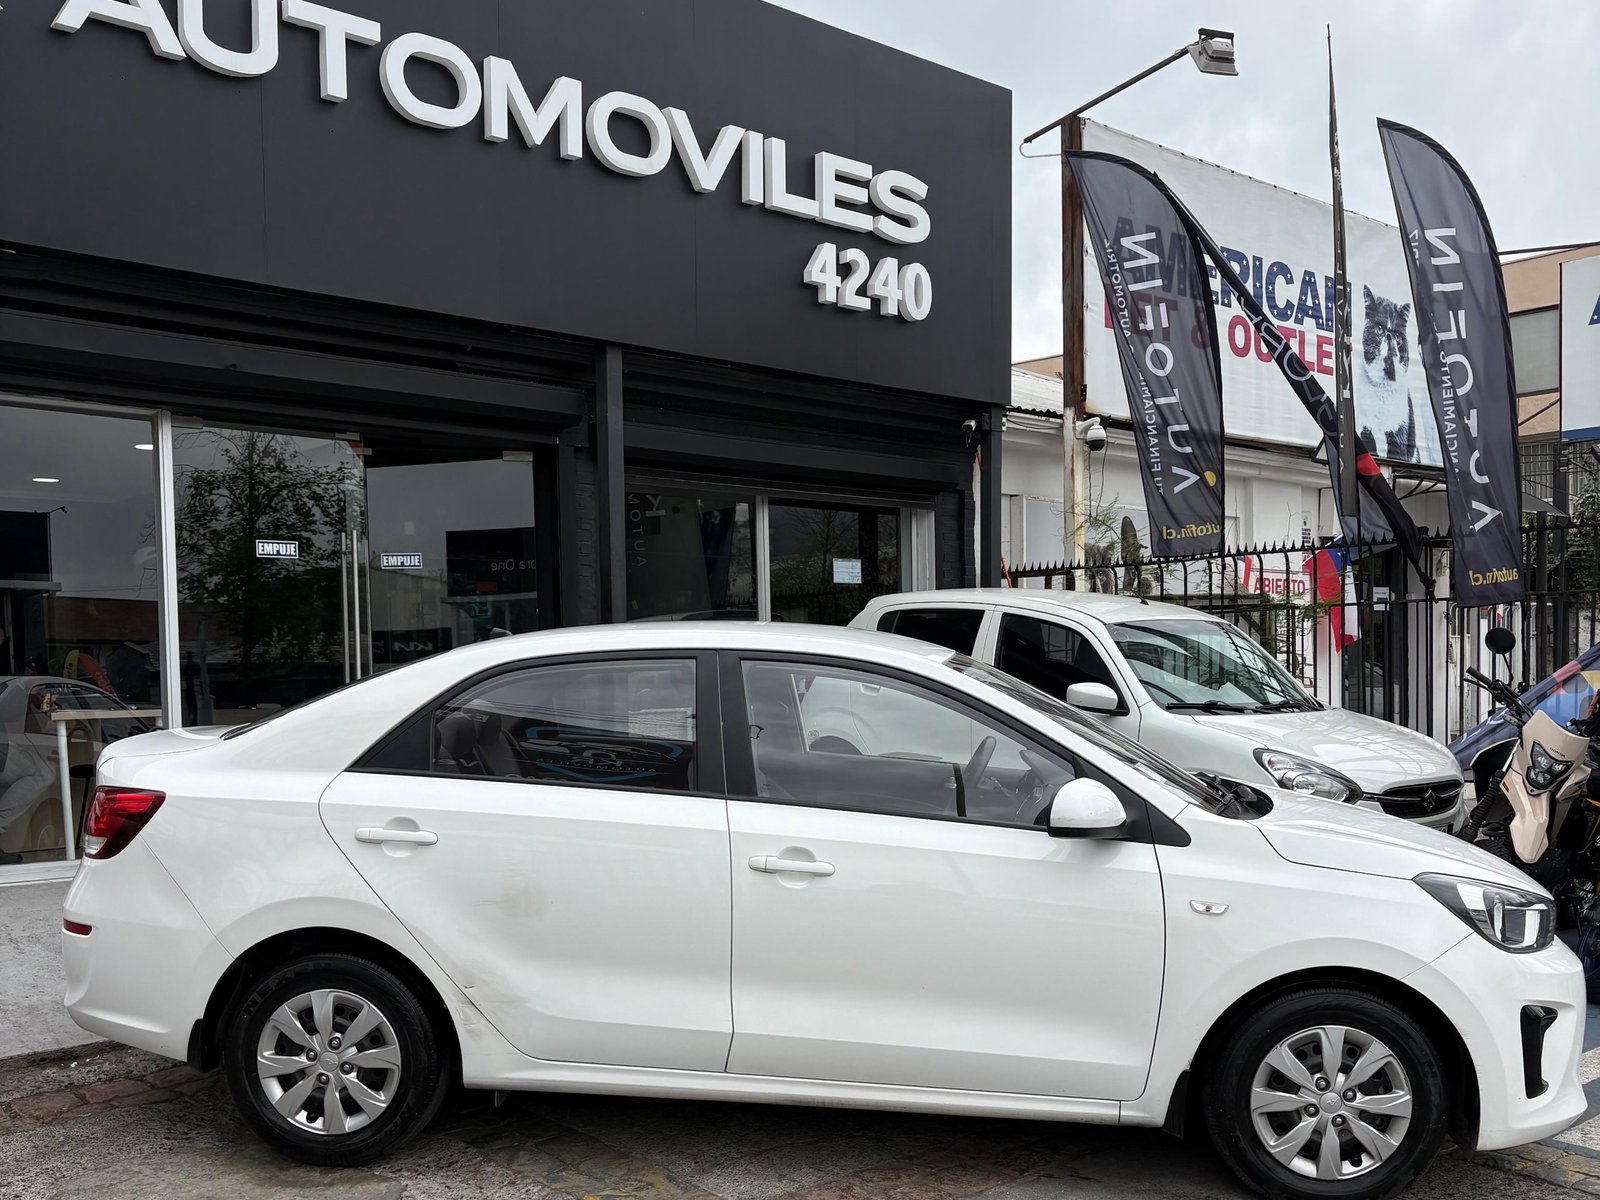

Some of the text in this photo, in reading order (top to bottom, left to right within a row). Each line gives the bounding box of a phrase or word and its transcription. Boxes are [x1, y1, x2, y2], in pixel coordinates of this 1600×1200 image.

[803, 242, 932, 322] 4240
[1110, 216, 1352, 337] AMERICAN
[1228, 315, 1352, 376] OUTLE
[258, 543, 297, 556] EMPUJE
[382, 555, 421, 567] EMPUJE
